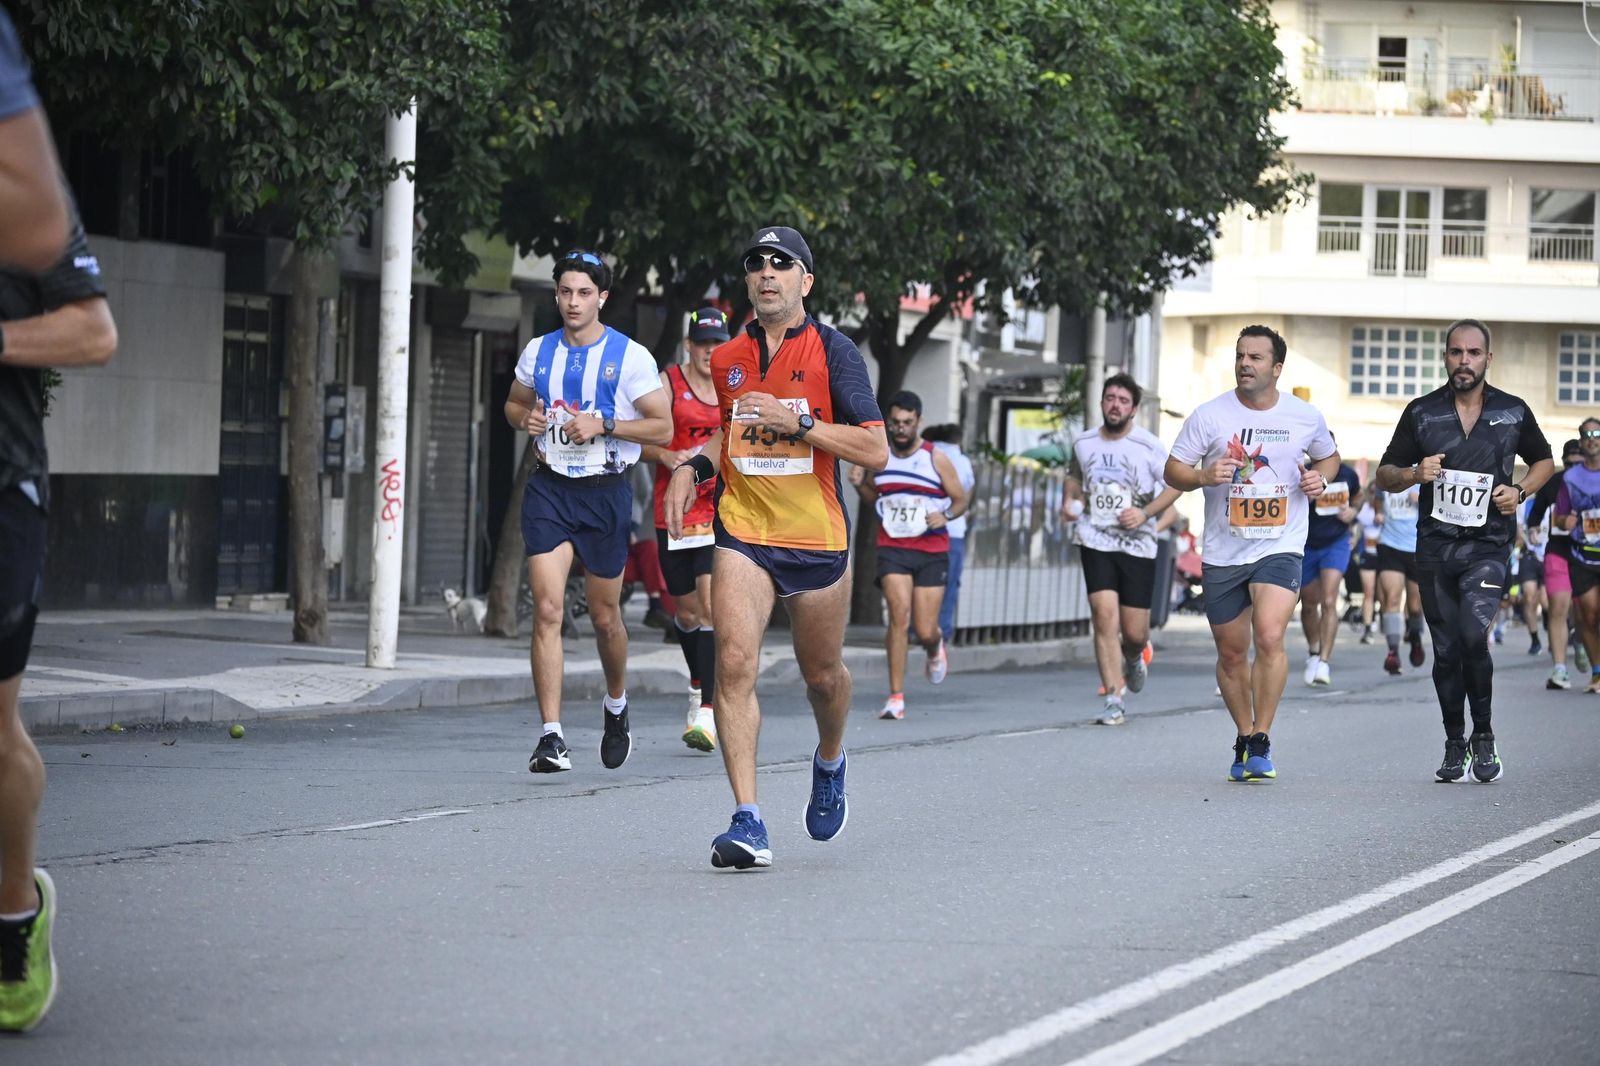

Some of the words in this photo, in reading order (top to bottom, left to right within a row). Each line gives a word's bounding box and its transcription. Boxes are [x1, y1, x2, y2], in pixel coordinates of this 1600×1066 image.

[560, 454, 585, 462] Huelva
[748, 458, 785, 469] Huelva
[1232, 486, 1245, 495] 2K
[1274, 485, 1286, 494] 2K
[1437, 483, 1488, 507] 1107
[1096, 495, 1123, 509] 692
[1239, 498, 1280, 518] 196
[891, 507, 918, 522] 757
[1244, 526, 1272, 535] Huelva
